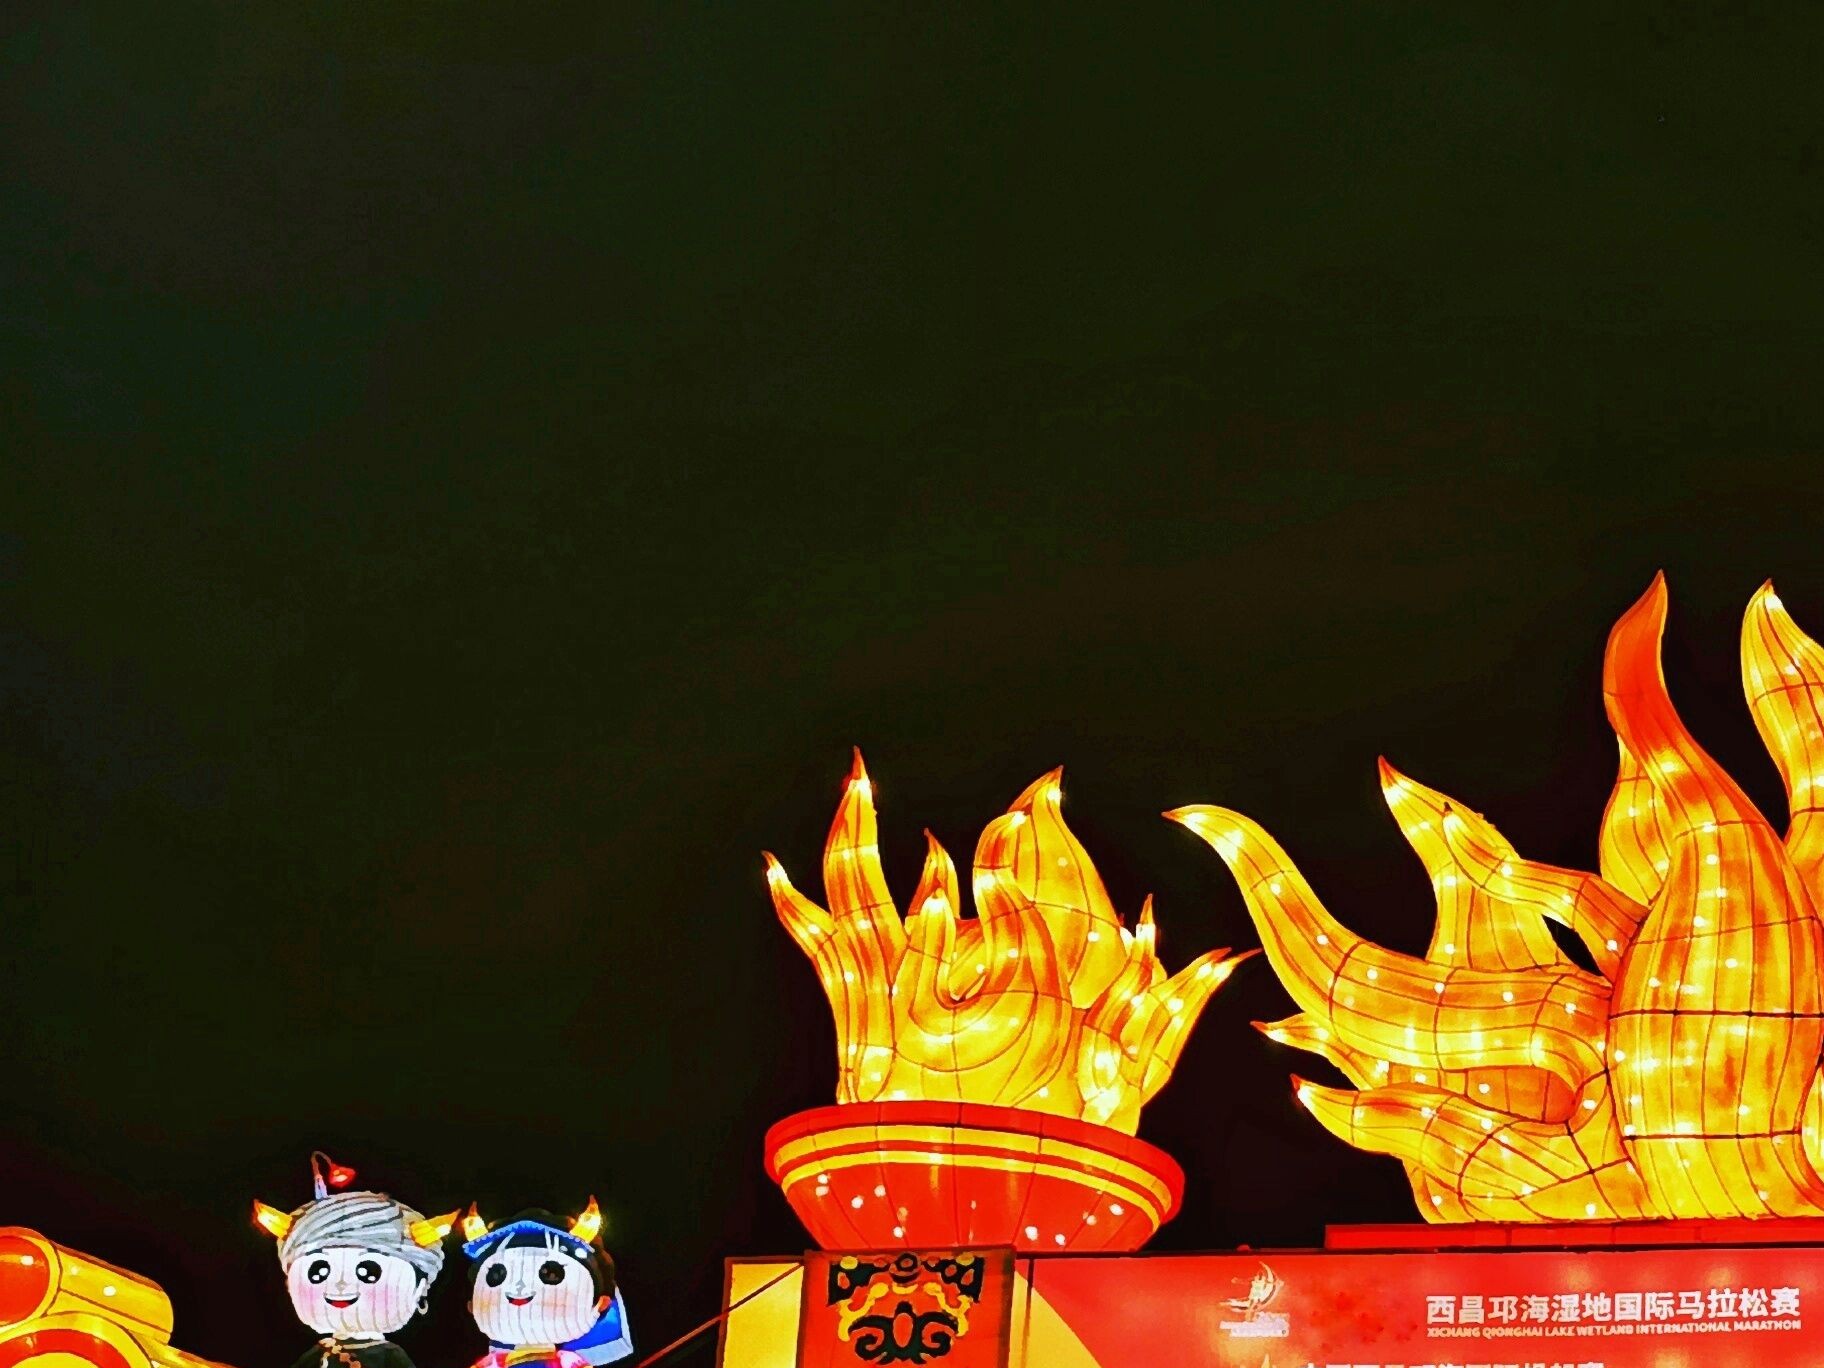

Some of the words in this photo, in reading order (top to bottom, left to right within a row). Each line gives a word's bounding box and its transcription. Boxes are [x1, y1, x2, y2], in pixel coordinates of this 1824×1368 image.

[1426, 1287, 1800, 1325] 西昌邛海湿地国际马拉松赛
[1427, 1327, 1480, 1338] XICHANG
[1483, 1326, 1542, 1339] QIONGHAI
[1545, 1326, 1575, 1337] LAKE
[1577, 1324, 1634, 1336] WETLAND
[1636, 1321, 1732, 1335] INTERNATIONAL
[1734, 1319, 1801, 1332] MARATHON
